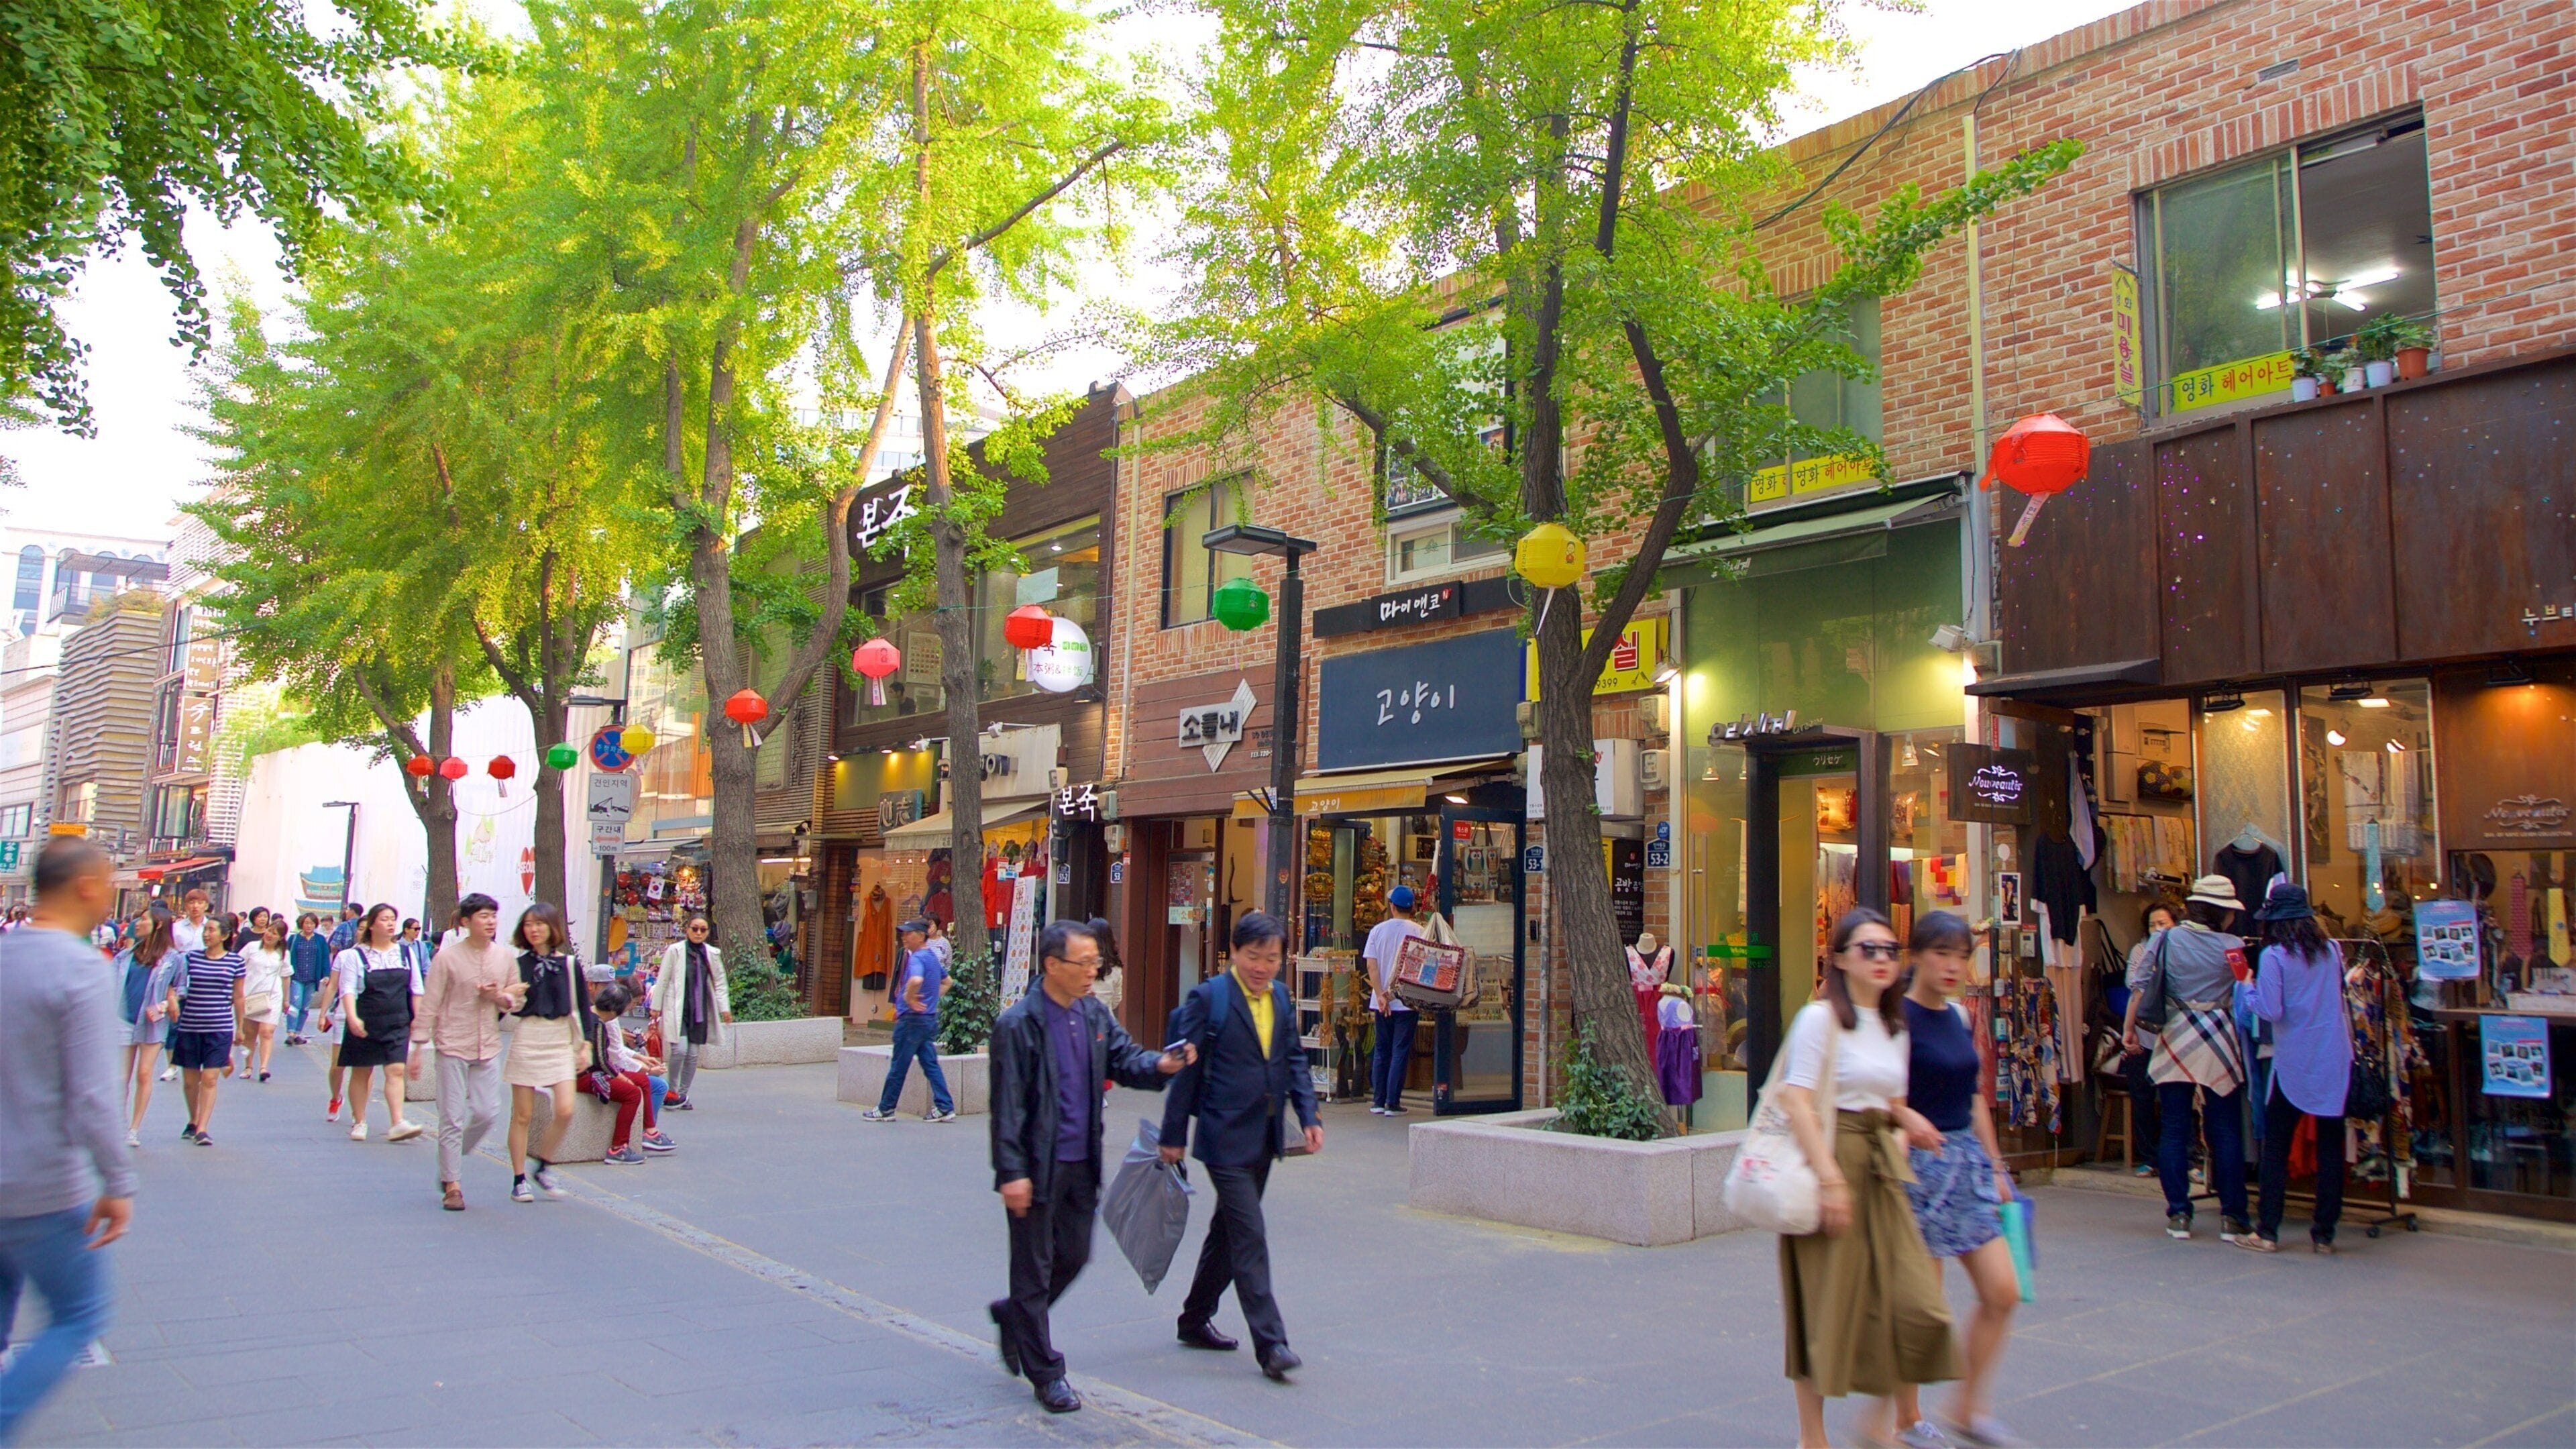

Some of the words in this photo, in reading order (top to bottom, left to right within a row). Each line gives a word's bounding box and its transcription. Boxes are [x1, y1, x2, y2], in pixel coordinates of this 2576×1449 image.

[2117, 311, 2135, 386] 미용실
[2182, 373, 2214, 402] 영화
[2221, 360, 2292, 393] 헤어아트
[1754, 472, 1778, 495] 영화
[1796, 464, 1820, 487] 영화
[1596, 678, 1618, 689] 9399
[1377, 681, 1455, 726] 고양이
[594, 779, 628, 788] 견인지역
[1059, 784, 1099, 822] 본죽
[1309, 798, 1340, 812] 고양이
[596, 826, 621, 834] 구간내
[1650, 853, 1668, 865] 53-2
[1615, 877, 1632, 893] 공방
